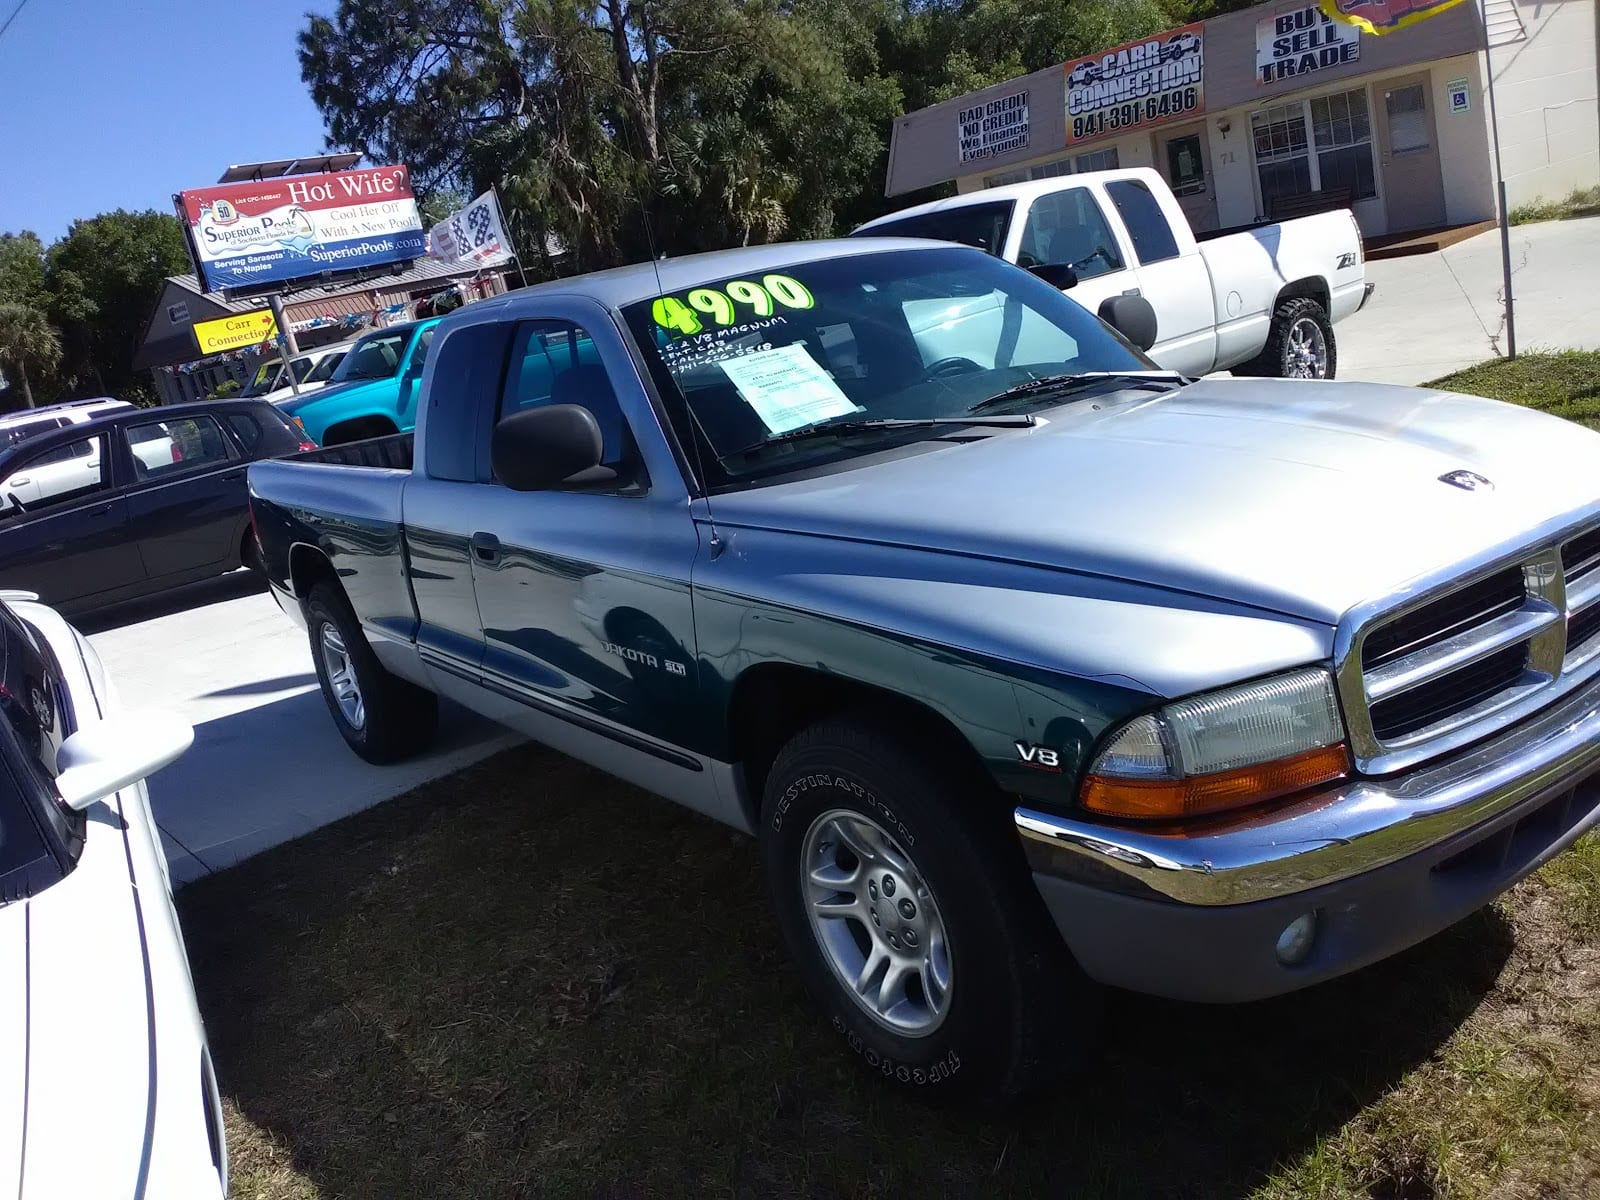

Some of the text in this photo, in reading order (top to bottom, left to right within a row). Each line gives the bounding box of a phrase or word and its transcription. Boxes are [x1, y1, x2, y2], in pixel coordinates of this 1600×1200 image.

[1272, 24, 1343, 58] SELL
[1101, 40, 1161, 79] CARR
[1259, 41, 1359, 84] TRADE
[1069, 55, 1200, 116] CONNECTION
[959, 93, 1027, 125] BAD CREDIT
[1072, 87, 1197, 139] 941-391-6496
[960, 123, 1028, 150] We Finance
[963, 109, 1023, 138] NO CREDIT
[1219, 151, 1236, 165] 71
[286, 170, 405, 204] Hot Wife?
[217, 206, 230, 219] 50
[330, 201, 401, 221] Cool Her Off
[320, 216, 417, 239] With A New Pool!
[214, 252, 284, 269] Serving Sarasota
[310, 237, 421, 262] SuperiorPools.com
[231, 263, 272, 275] To Naples
[652, 274, 815, 335] 4990
[207, 329, 272, 348] Connection
[225, 319, 251, 331] Carr
[693, 333, 713, 345] V8
[717, 316, 788, 338] MAGNUM
[697, 340, 726, 352] CAB
[600, 640, 658, 669] DAKOTA
[1015, 743, 1059, 767] V8
[771, 773, 916, 847] DESTINATION
